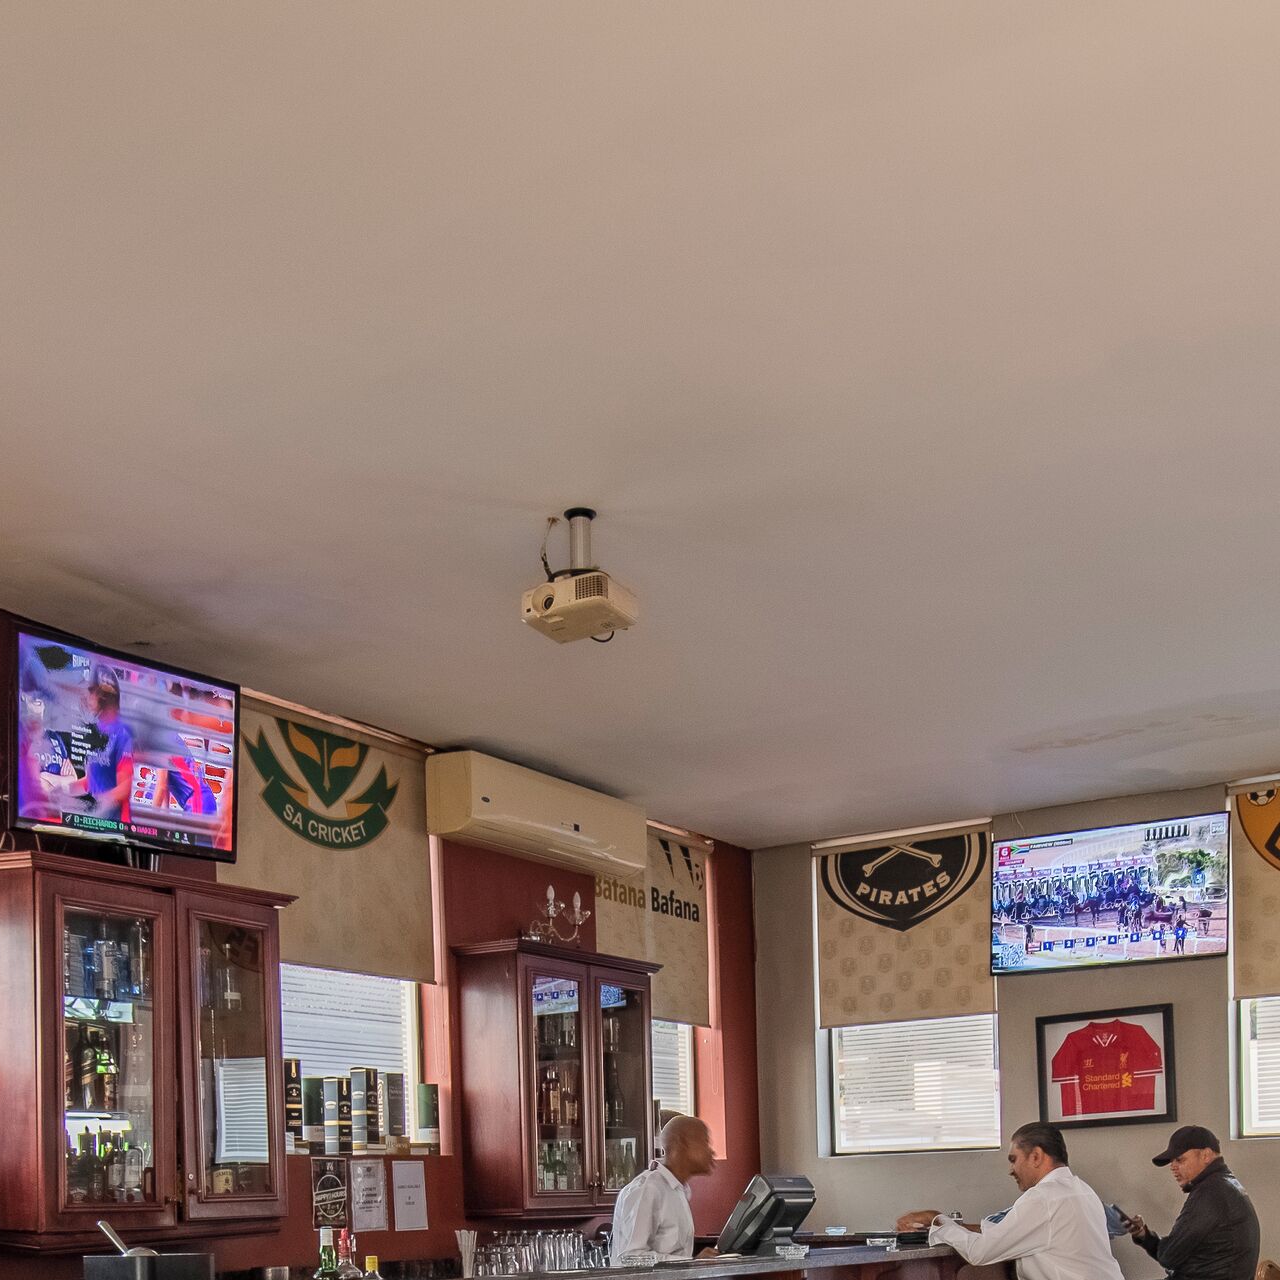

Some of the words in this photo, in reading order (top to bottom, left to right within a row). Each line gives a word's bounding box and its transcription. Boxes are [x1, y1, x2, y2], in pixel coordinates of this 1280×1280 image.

[283, 803, 303, 830] SA
[308, 820, 367, 844] CRICKET
[1001, 847, 1009, 856] 6
[856, 871, 951, 905] PIRATES
[651, 886, 700, 922] Bafana
[1083, 1082, 1120, 1091] Chartered
[1085, 1073, 1120, 1082] Standard
